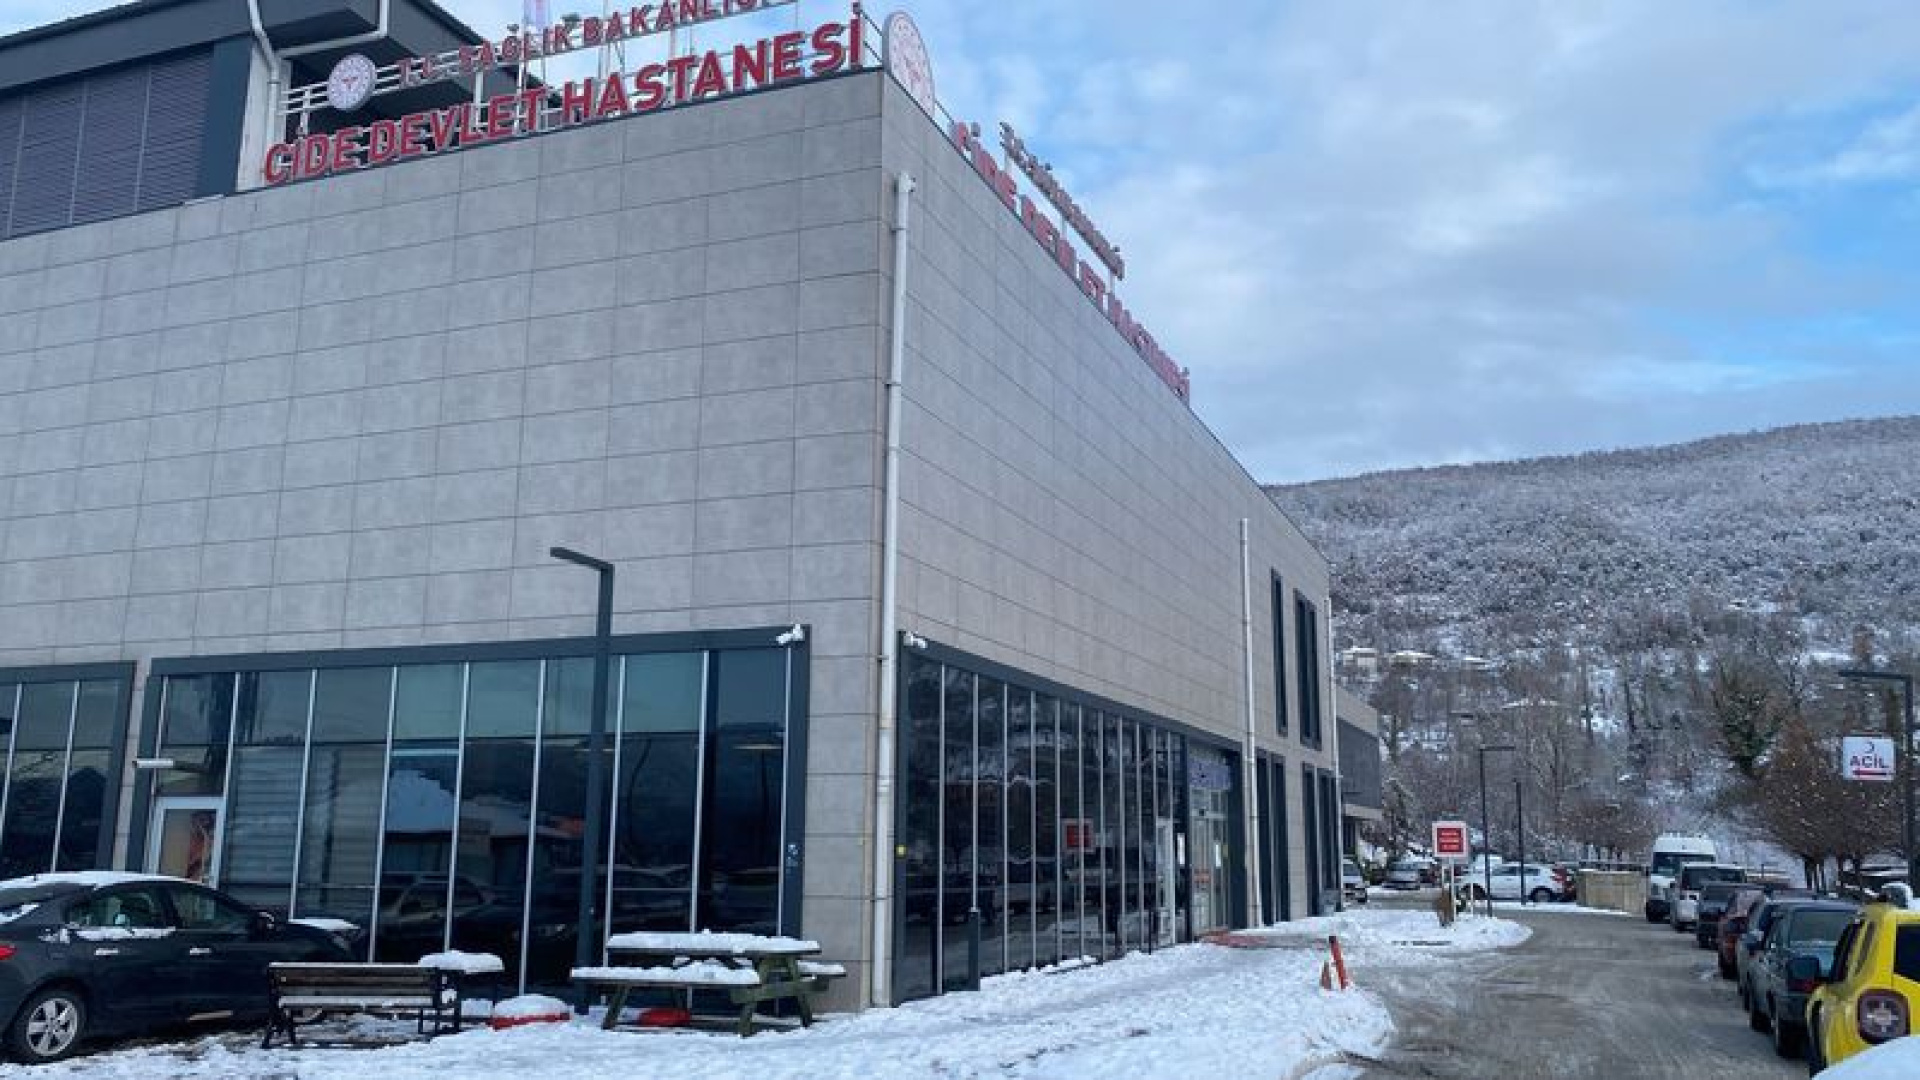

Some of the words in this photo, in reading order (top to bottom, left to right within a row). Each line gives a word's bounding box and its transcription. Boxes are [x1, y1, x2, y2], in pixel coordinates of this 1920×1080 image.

[263, 125, 364, 186] CİDE
[367, 88, 548, 164] DEVLET
[562, 2, 866, 122] HASTANESİ
